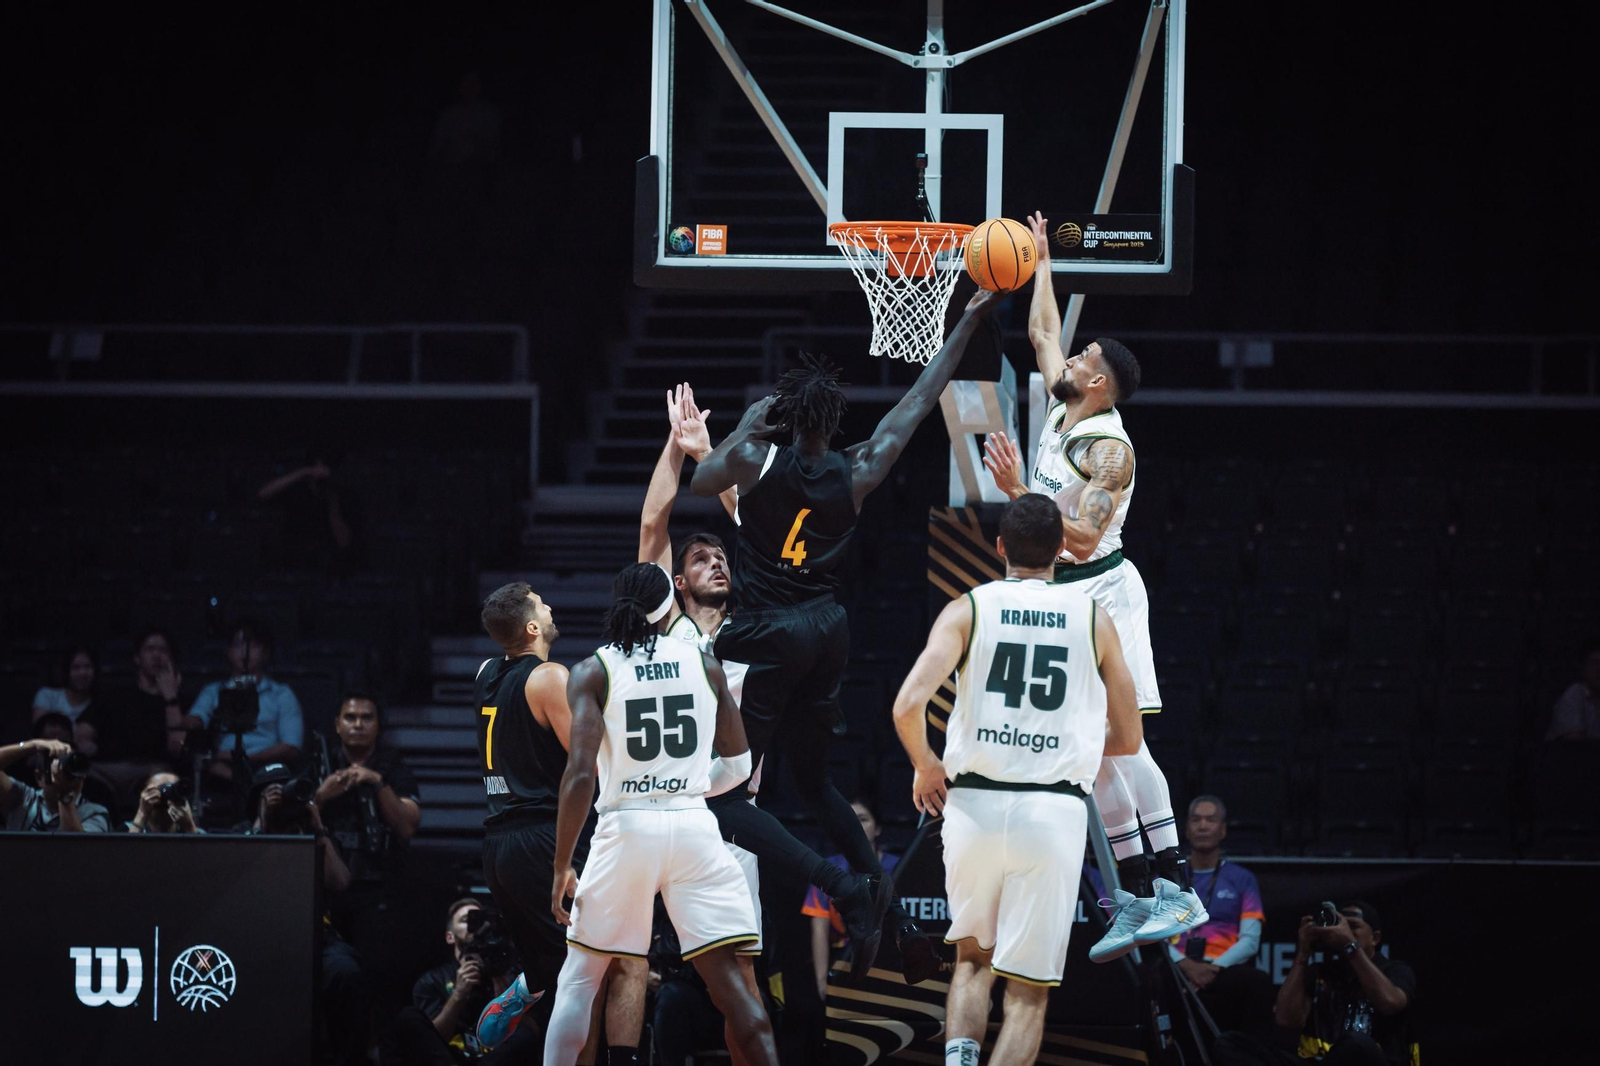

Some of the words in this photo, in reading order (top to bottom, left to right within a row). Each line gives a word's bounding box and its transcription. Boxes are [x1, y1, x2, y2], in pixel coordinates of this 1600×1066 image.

[702, 228, 723, 239] FIBA
[1083, 230, 1153, 240] INTERCONTINENTAL
[1083, 239, 1099, 248] CUP
[1103, 241, 1129, 249] Singapore
[1021, 246, 1030, 263] FIBA
[780, 507, 813, 567] 4
[1000, 609, 1067, 629] KRAVISH
[634, 661, 680, 682] PERRY
[985, 641, 1069, 712] 45
[625, 693, 698, 762] 55
[481, 706, 498, 770] 7
